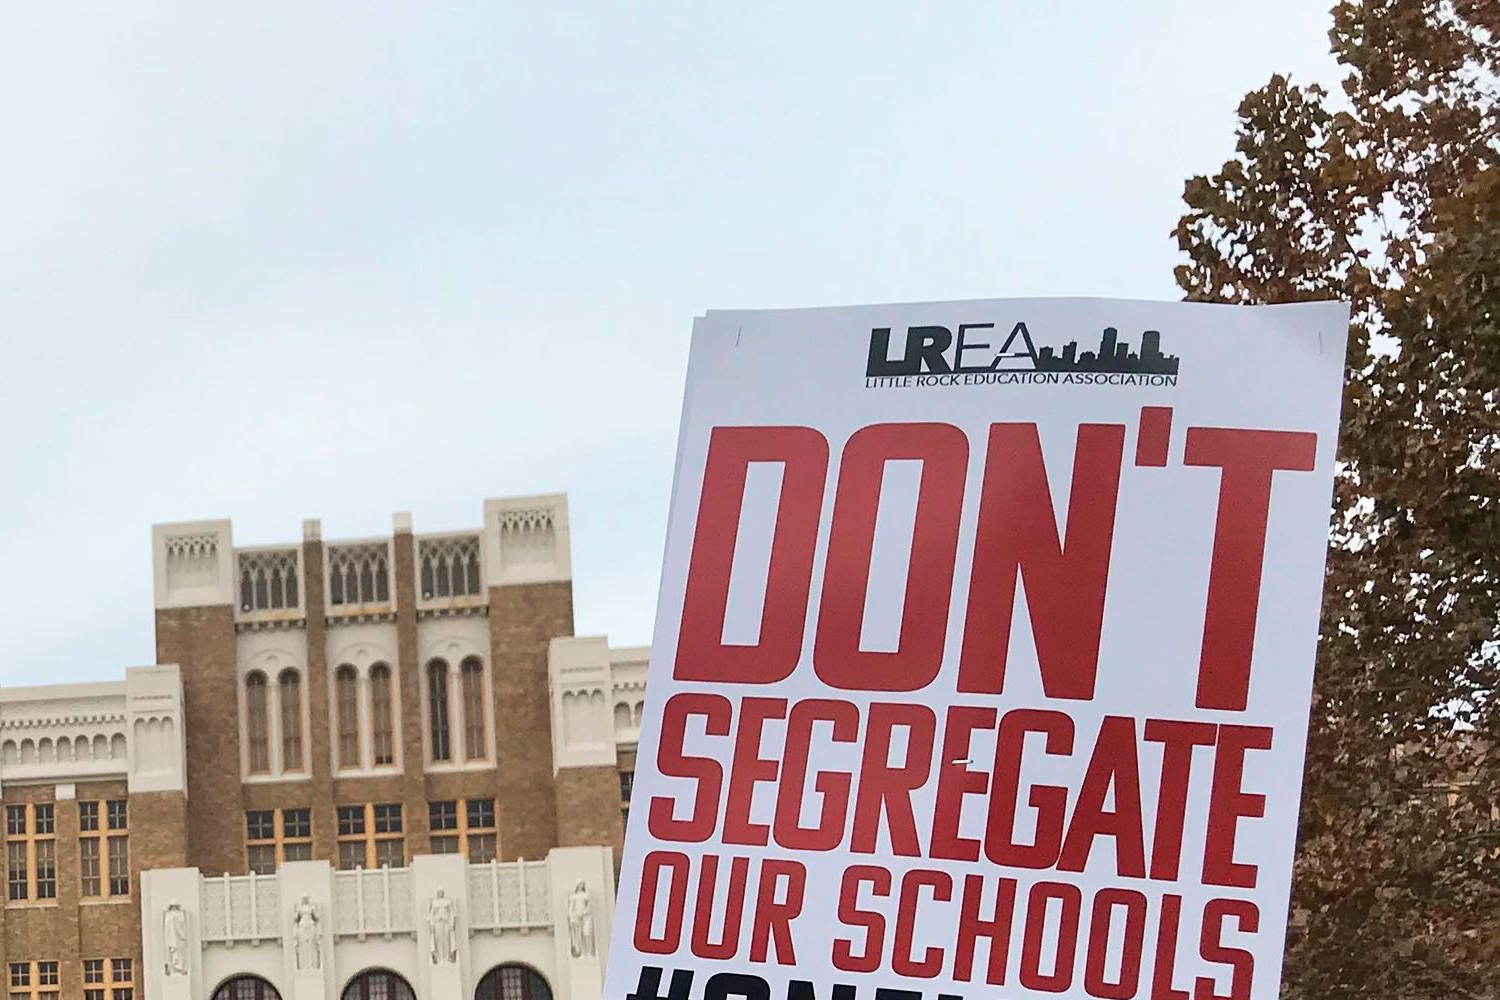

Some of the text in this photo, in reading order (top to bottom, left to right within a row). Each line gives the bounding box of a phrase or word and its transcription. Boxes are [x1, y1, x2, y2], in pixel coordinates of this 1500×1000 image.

[866, 322, 1039, 377] LREA
[866, 372, 1178, 389] LITTLE ROCK EDUCATION ASSOCIATION
[672, 406, 1317, 711] DON'T
[647, 693, 1273, 888] SEGREGATE
[632, 851, 806, 966] OUR
